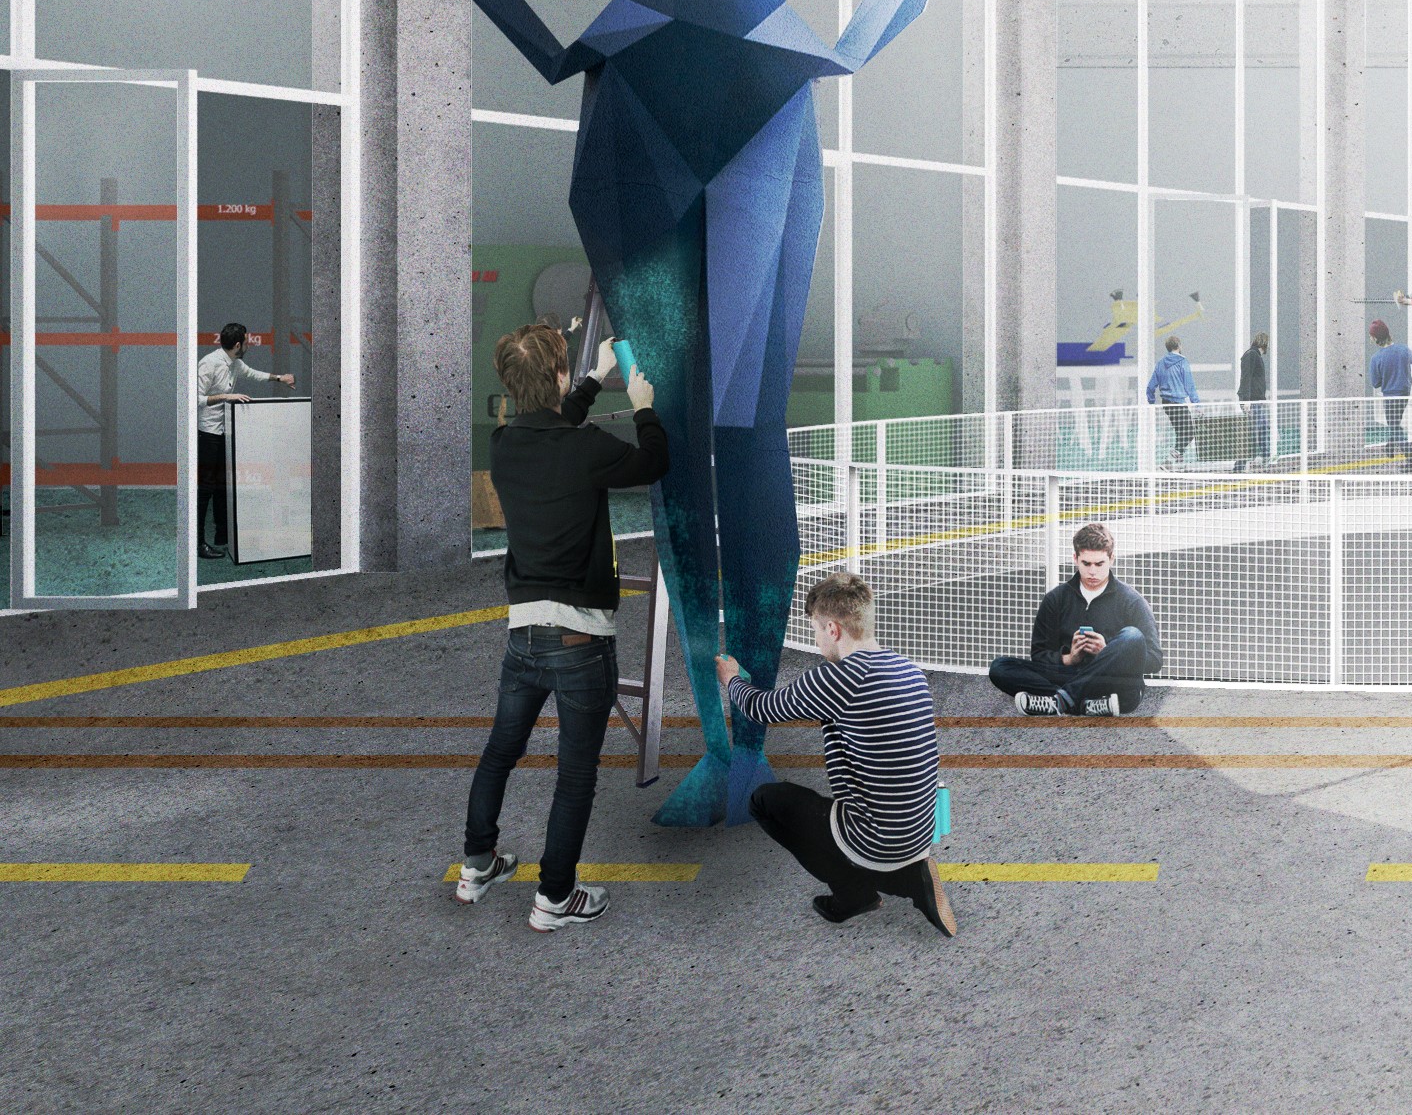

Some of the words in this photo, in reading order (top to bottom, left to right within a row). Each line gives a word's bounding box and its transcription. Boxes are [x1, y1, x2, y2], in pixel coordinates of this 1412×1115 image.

[217, 204, 242, 213] 1.200
[244, 204, 257, 216] kg
[248, 333, 262, 346] kg
